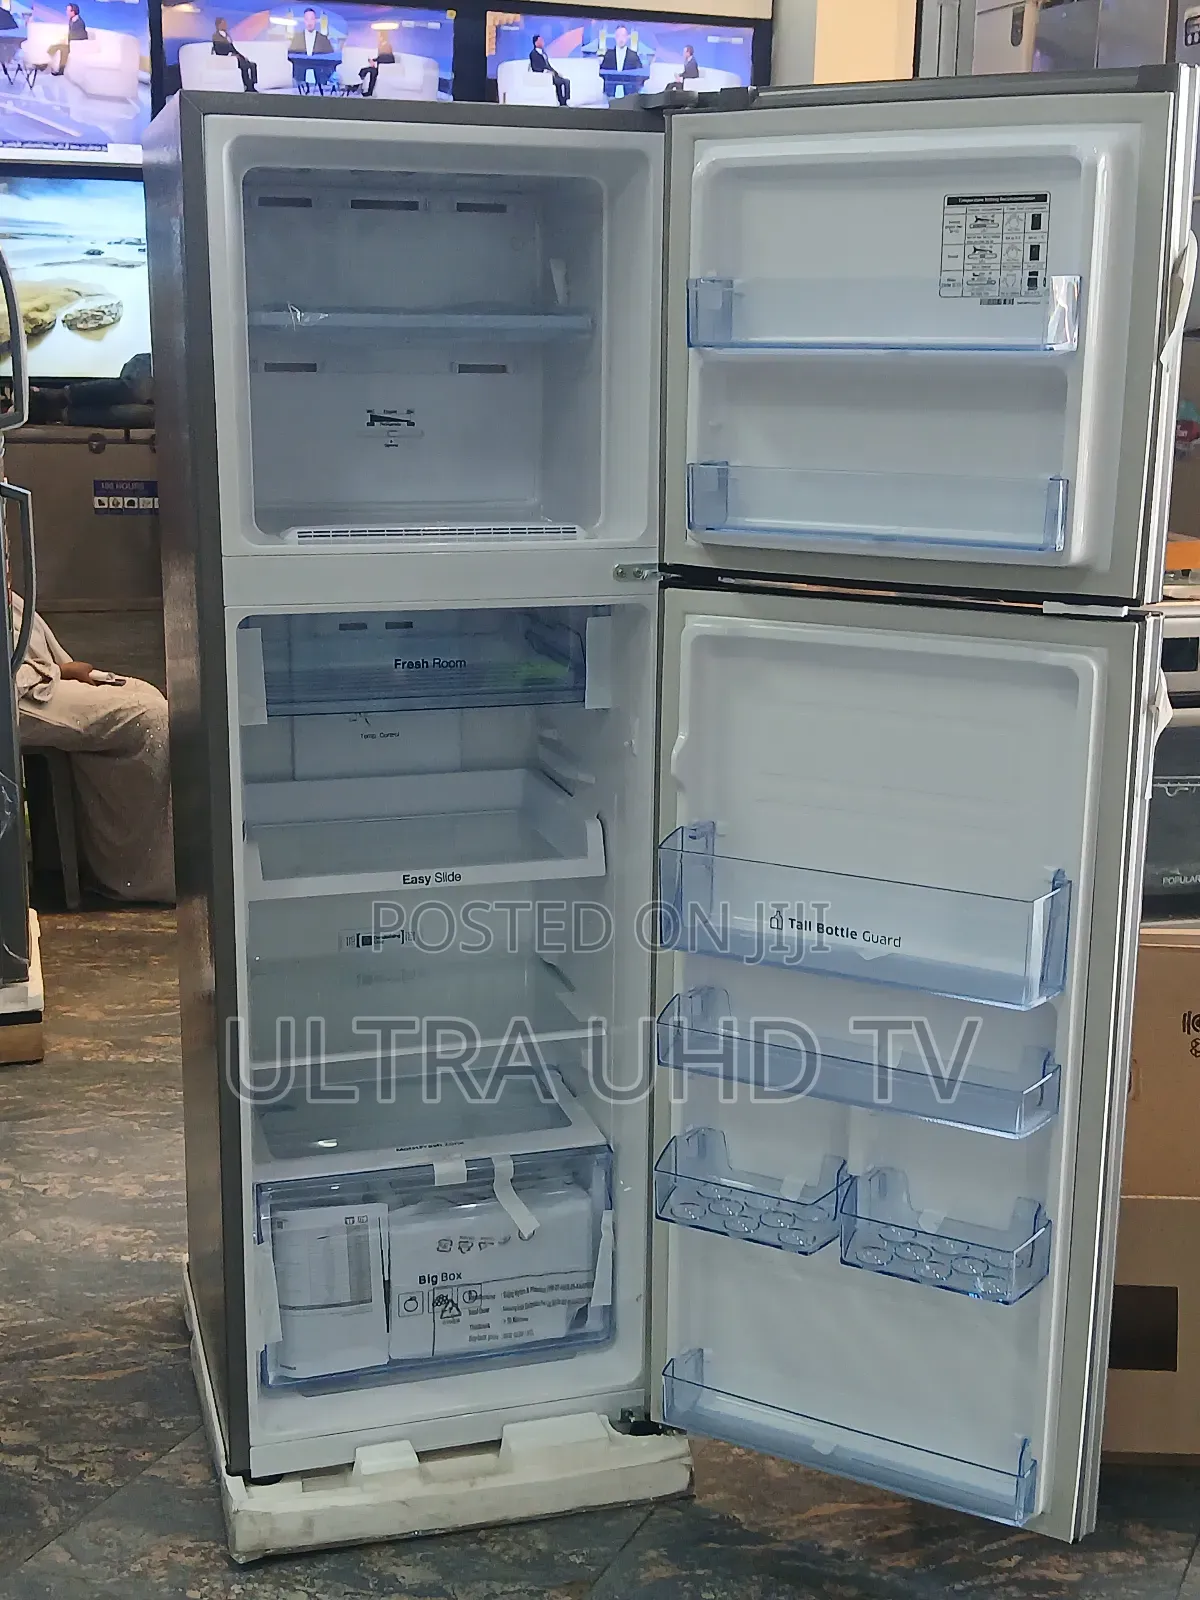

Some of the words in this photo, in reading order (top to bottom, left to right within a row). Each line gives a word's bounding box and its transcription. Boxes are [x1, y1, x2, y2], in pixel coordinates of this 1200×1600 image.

[394, 658, 429, 669] Fresh
[432, 657, 467, 669] Room
[402, 874, 431, 886] Easy
[434, 871, 462, 883] Slide
[788, 917, 812, 932] Tall
[816, 922, 858, 940] Bottle
[862, 930, 902, 948] Guard
[418, 1273, 438, 1286] Big
[441, 1271, 463, 1282] Box
